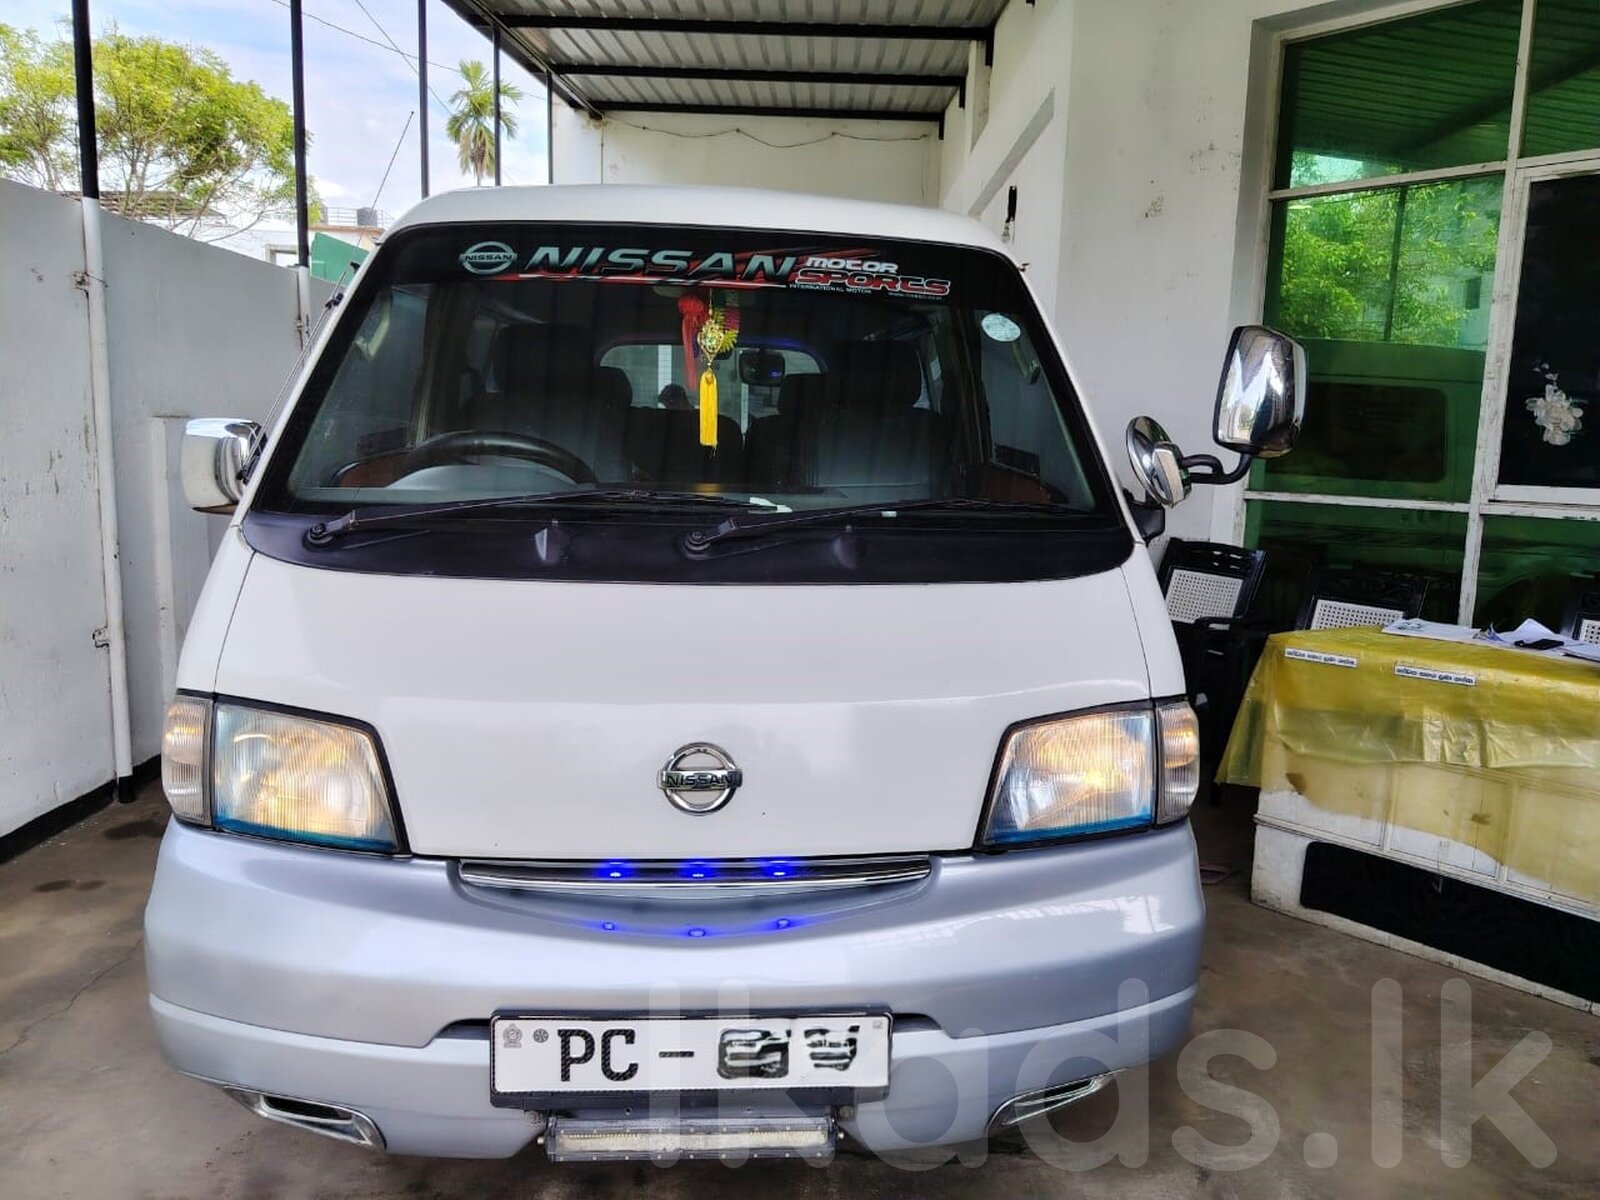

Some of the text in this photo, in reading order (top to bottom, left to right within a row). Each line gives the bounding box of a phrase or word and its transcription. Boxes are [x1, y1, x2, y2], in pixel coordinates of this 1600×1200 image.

[464, 251, 513, 262] NISSAN
[523, 246, 797, 282] NISSAN
[789, 283, 845, 293] INTERNATIONAL
[664, 773, 732, 788] NISSAN
[557, 1028, 639, 1082] PC
